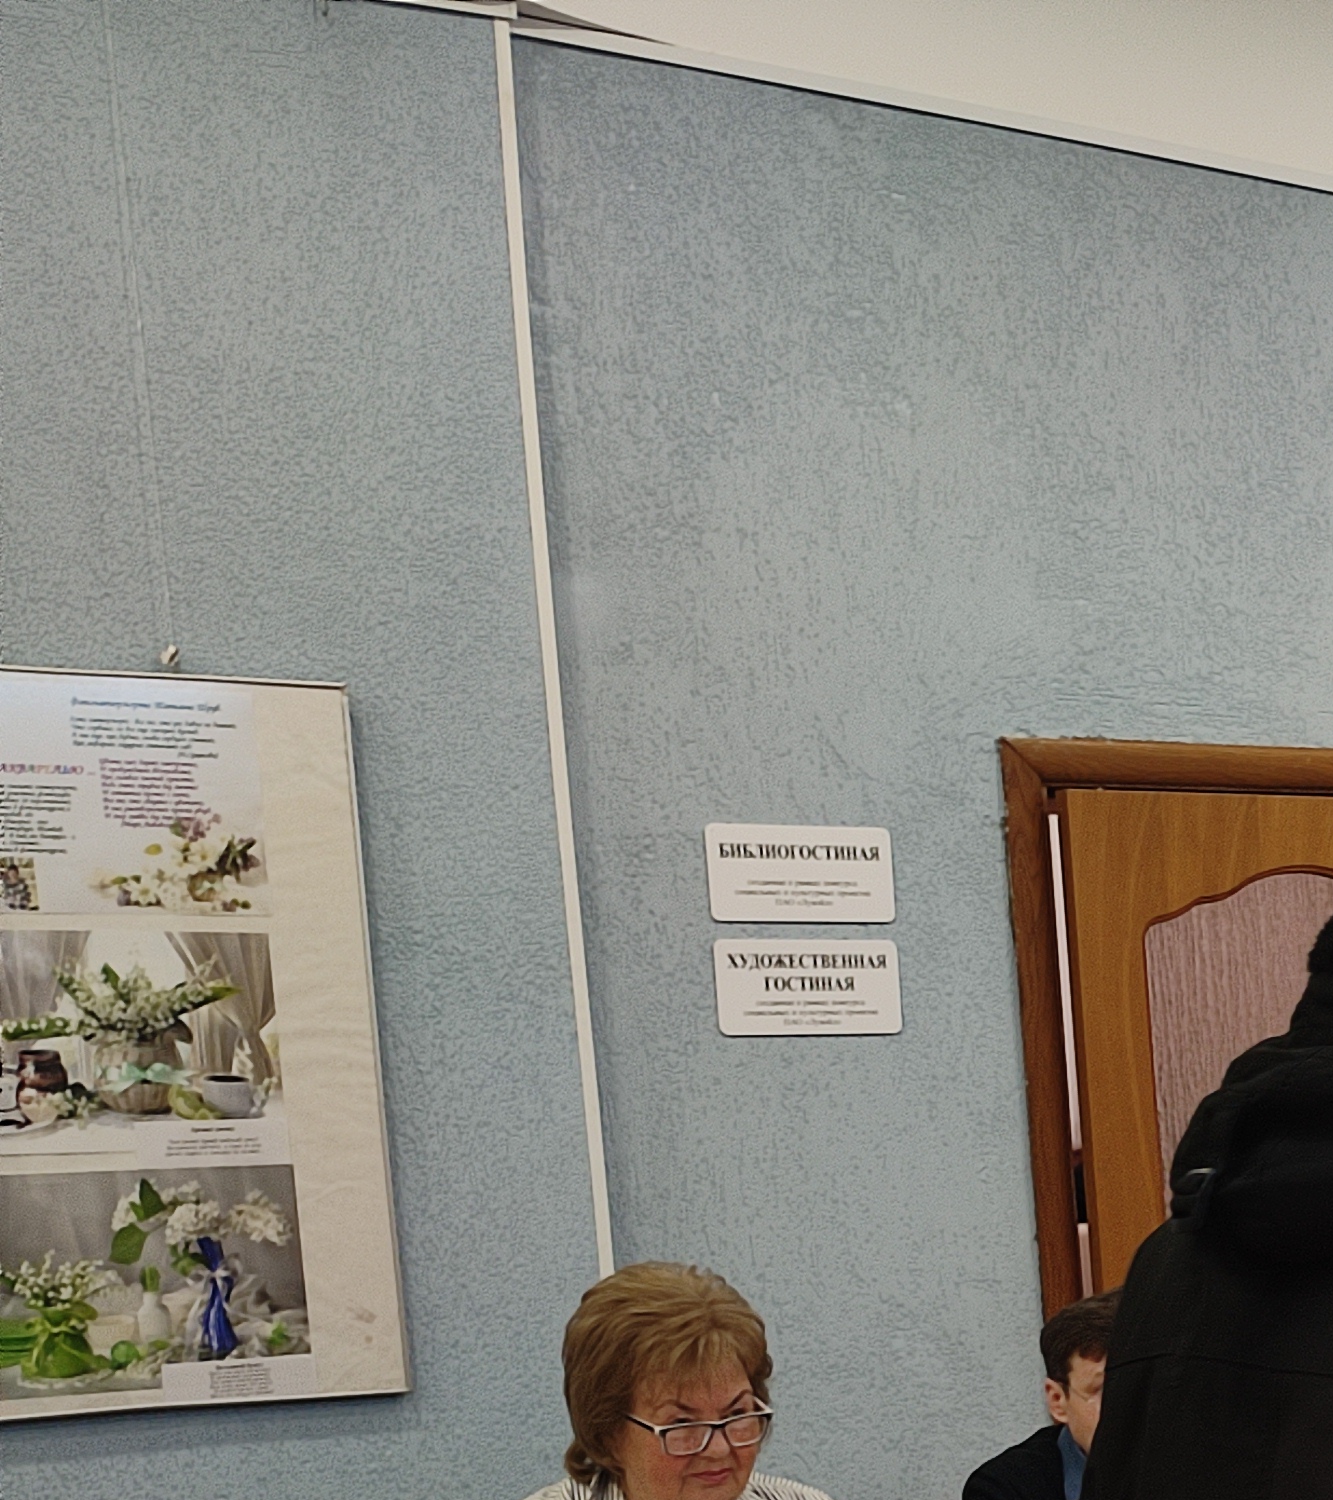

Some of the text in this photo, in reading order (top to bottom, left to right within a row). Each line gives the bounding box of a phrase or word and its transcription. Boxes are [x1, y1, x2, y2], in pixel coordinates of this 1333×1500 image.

[719, 843, 881, 861] БИБЛИОГОСТИНАЯ
[726, 953, 887, 971] ХУДОЖЕСТВЕННАЯ
[764, 976, 855, 991] ГОСТИНАЯ
